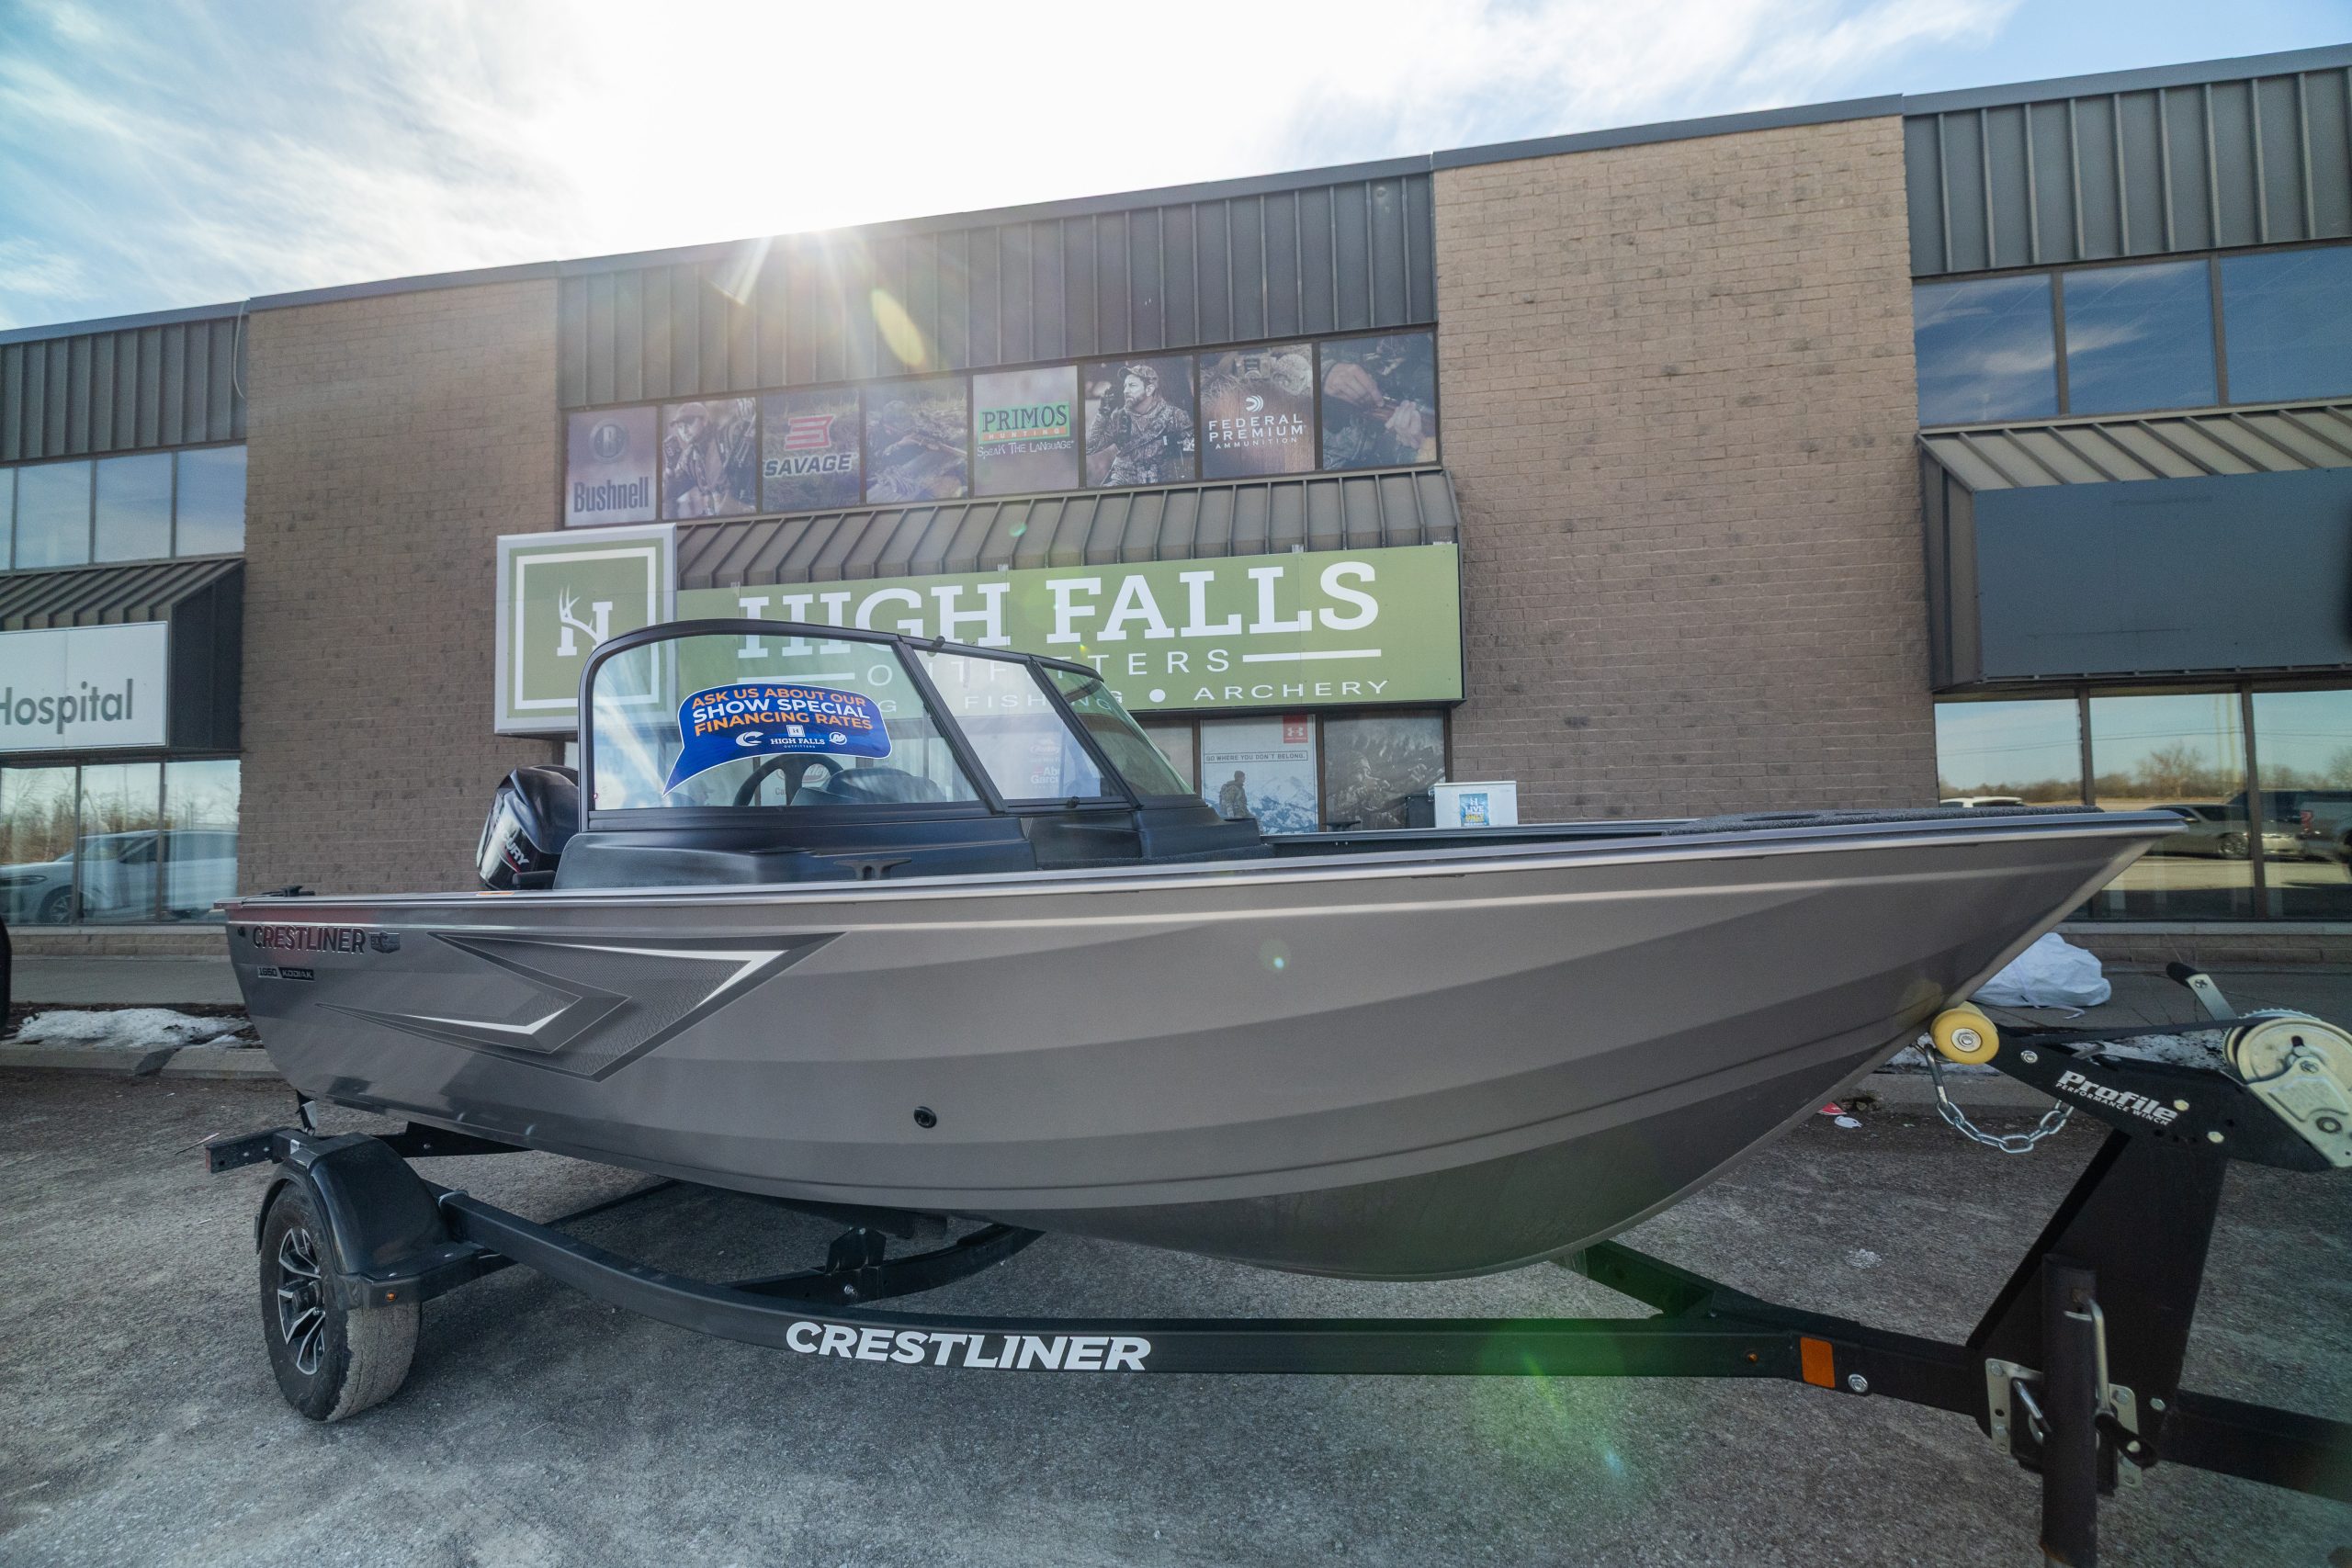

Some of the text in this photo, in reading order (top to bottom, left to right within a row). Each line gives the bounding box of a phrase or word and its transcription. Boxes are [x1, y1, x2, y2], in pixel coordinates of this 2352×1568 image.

[981, 404, 1068, 433] PRIMOS
[1208, 413, 1303, 431] FEDERAL
[989, 428, 1059, 440] HUNTING
[1208, 424, 1304, 443] PREMIUM
[1215, 437, 1297, 450] AMMUNITION
[763, 453, 852, 477] SAVAGE
[573, 477, 650, 513] Bushnell
[738, 561, 1379, 660] HIGH FALLS
[866, 649, 1230, 686] OTFTTERS
[692, 691, 729, 710] ASK
[734, 688, 759, 699] US
[764, 688, 826, 700] ABOUT
[830, 693, 866, 706] OUR
[965, 680, 1390, 709] FISHNG ARCHERY
[693, 698, 770, 724] SHOW
[778, 698, 871, 719] SPECIAL
[695, 711, 873, 737] FINANCING RATES
[252, 924, 367, 955] CRESTLINER
[282, 969, 313, 978] KODIAK
[2055, 1082, 2169, 1126] PERFORMANCE WINCH
[2057, 1070, 2178, 1122] Profile
[786, 1321, 1151, 1371] CRESTLINER
